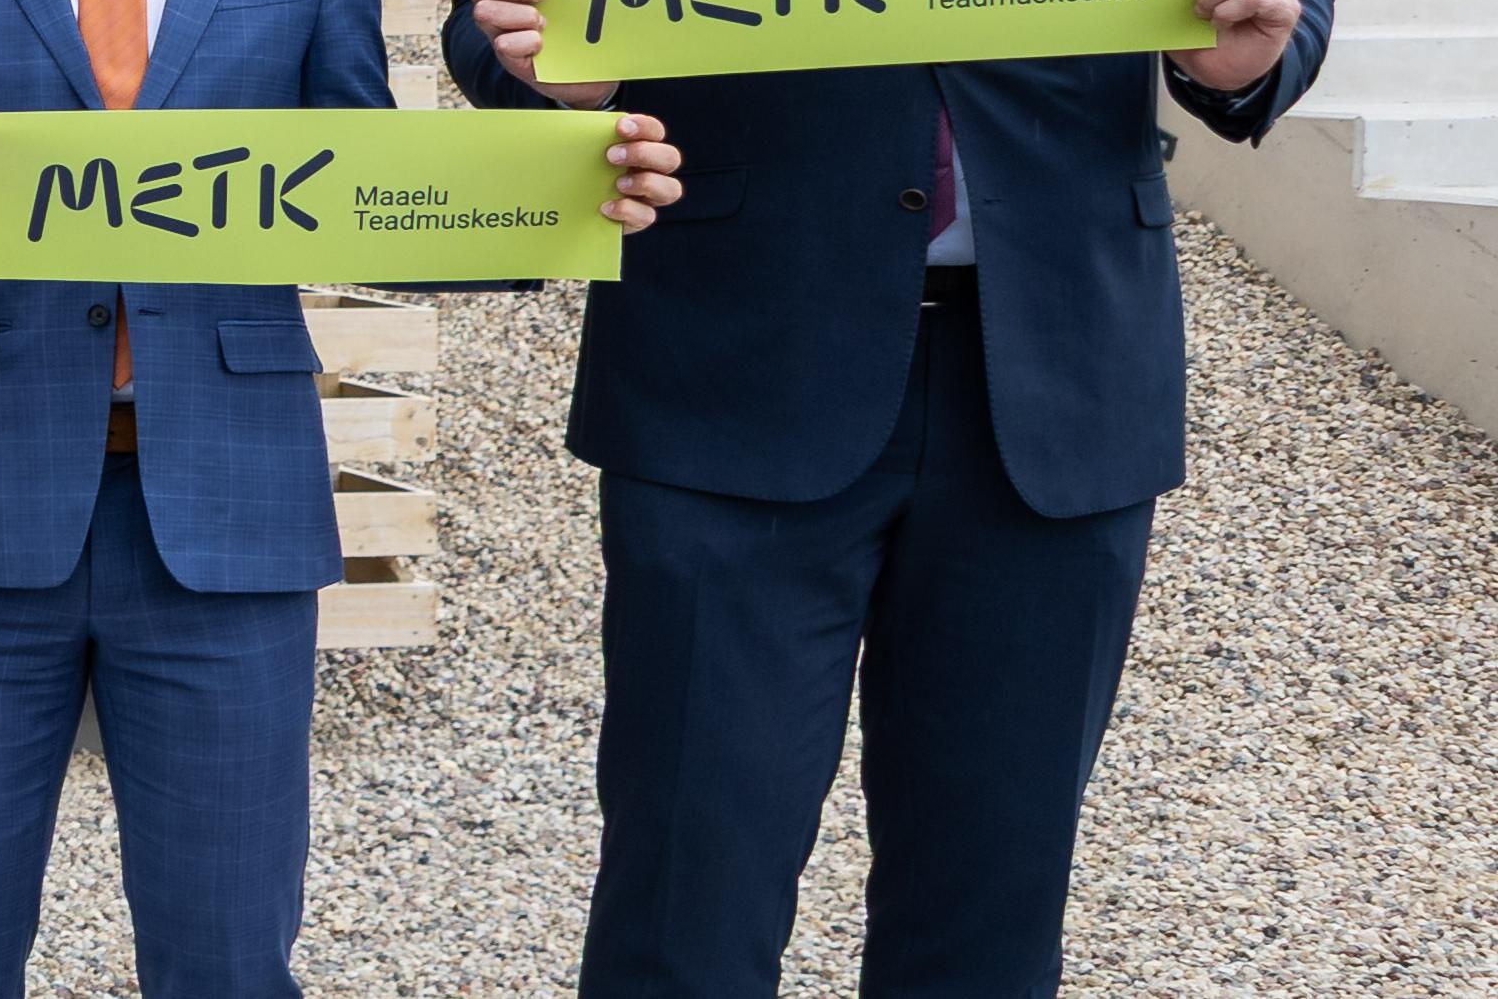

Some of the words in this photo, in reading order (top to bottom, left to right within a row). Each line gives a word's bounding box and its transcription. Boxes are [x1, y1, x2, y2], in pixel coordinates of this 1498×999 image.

[27, 146, 335, 243] METK
[355, 184, 449, 207] Maaelu
[353, 206, 560, 232] Teadmuskeskus
